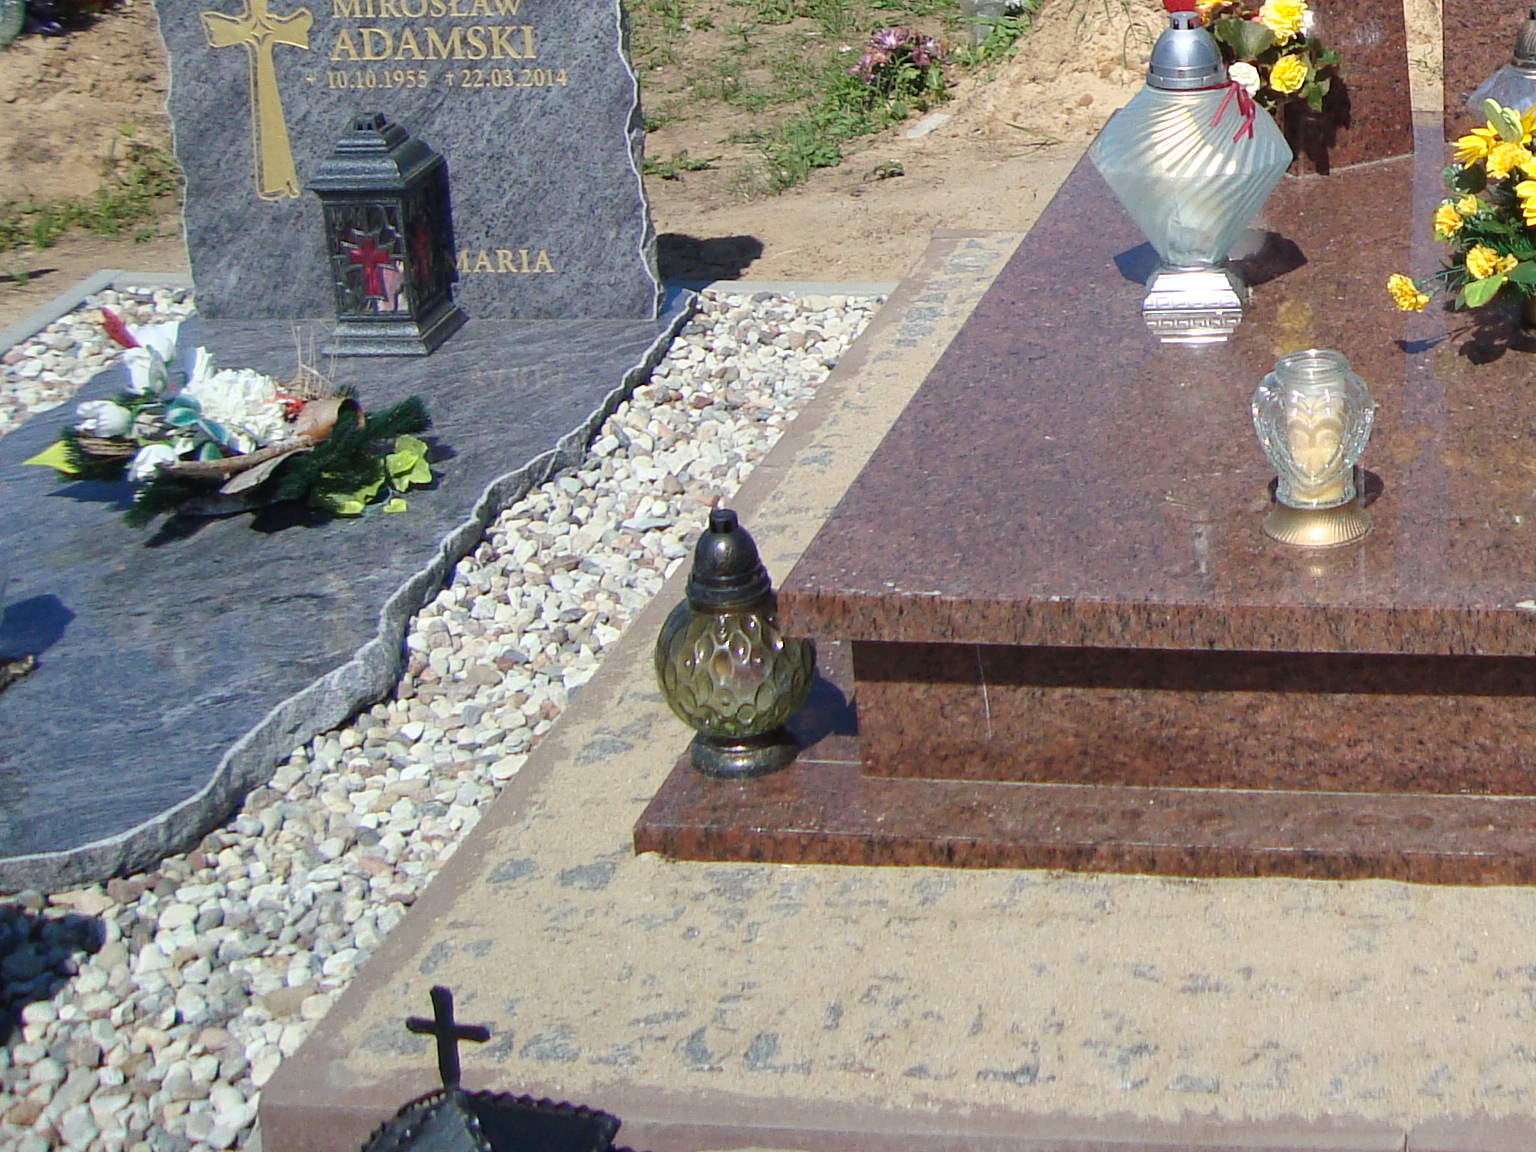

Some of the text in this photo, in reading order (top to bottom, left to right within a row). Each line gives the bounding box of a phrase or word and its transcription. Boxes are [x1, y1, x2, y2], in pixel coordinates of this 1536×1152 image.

[330, 25, 537, 61] ADAMSKI
[326, 68, 569, 90] 10.10.1955 22.03.2014
